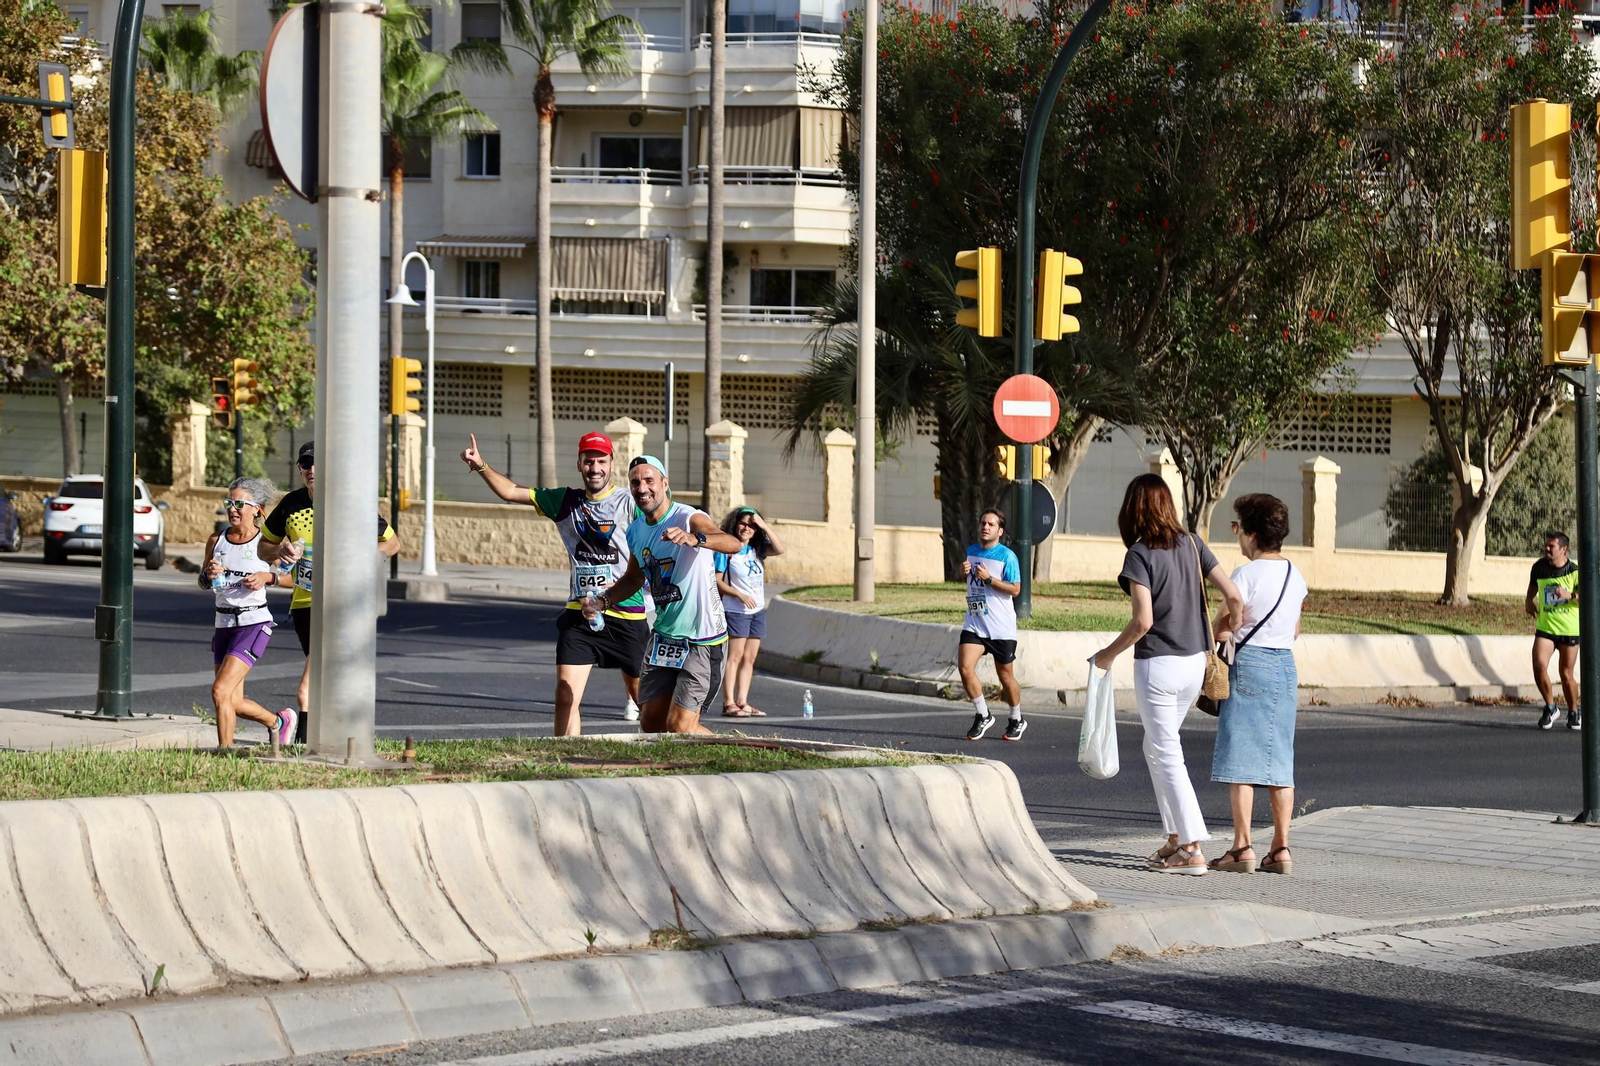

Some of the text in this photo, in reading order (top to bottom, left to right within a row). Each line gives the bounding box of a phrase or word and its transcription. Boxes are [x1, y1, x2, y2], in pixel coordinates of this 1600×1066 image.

[299, 567, 312, 581] 54
[579, 576, 606, 587] 642
[658, 645, 684, 659] 625
